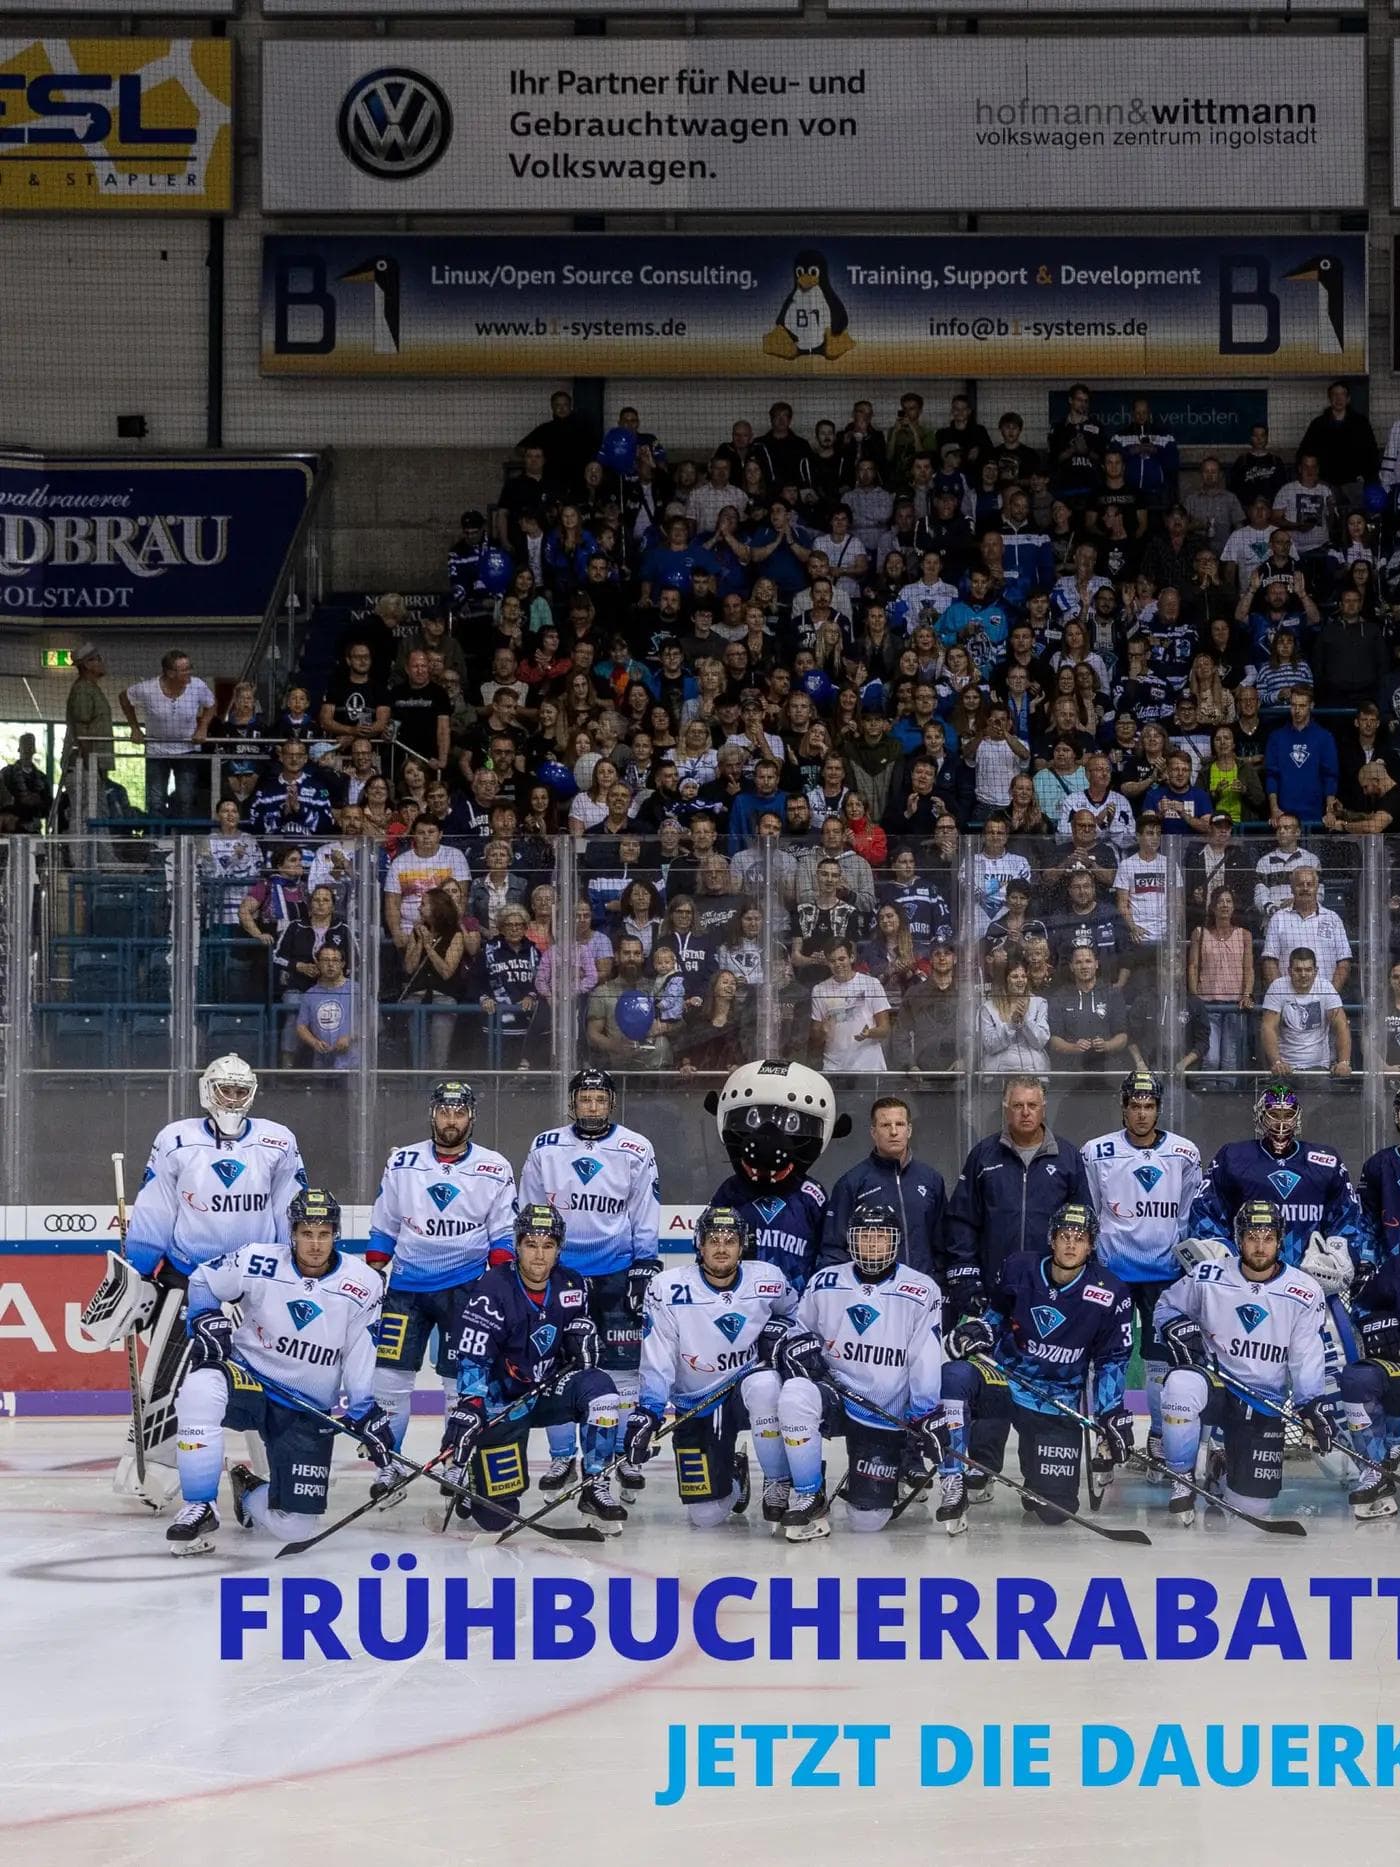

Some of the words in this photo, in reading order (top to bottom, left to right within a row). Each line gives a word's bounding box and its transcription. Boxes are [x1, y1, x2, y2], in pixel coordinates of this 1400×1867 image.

[509, 69, 550, 96] Ihr
[558, 69, 668, 96] Partner
[677, 68, 717, 96] für
[727, 69, 800, 96] Neu-
[808, 68, 866, 96] und
[975, 97, 1317, 126] hofmann&wittmann
[509, 111, 788, 144] Gebrauchtwagen
[799, 115, 858, 137] von
[975, 127, 1104, 150] volkswagen
[1112, 129, 1200, 146] zentrum
[1209, 127, 1317, 149] ingolstadt
[67, 173, 197, 186] STAPLER
[509, 153, 717, 187] Volkswagen.
[431, 264, 555, 288] Linux/Open
[563, 265, 632, 285] Source
[640, 264, 758, 290] Consulting,
[847, 264, 940, 290] Training,
[943, 265, 1028, 289] Support
[1035, 266, 1053, 285] &
[1060, 264, 1201, 289] Development
[474, 317, 686, 341] www.b1-systems.de
[928, 317, 1148, 341] info@b1-systems.de
[1159, 403, 1240, 424] verboten
[535, 1132, 559, 1146] 80
[1096, 1141, 1115, 1158] 13
[393, 1151, 419, 1168] 37
[248, 1254, 278, 1278] 53
[1198, 1263, 1225, 1281] 97
[814, 1271, 839, 1289] 20
[670, 1283, 693, 1305] 21
[458, 1326, 490, 1357] 88
[1037, 1445, 1080, 1460] HERRN
[855, 1458, 898, 1480] CINQUE
[1039, 1463, 1076, 1477] BRÄU
[491, 1478, 523, 1493] EDEKA
